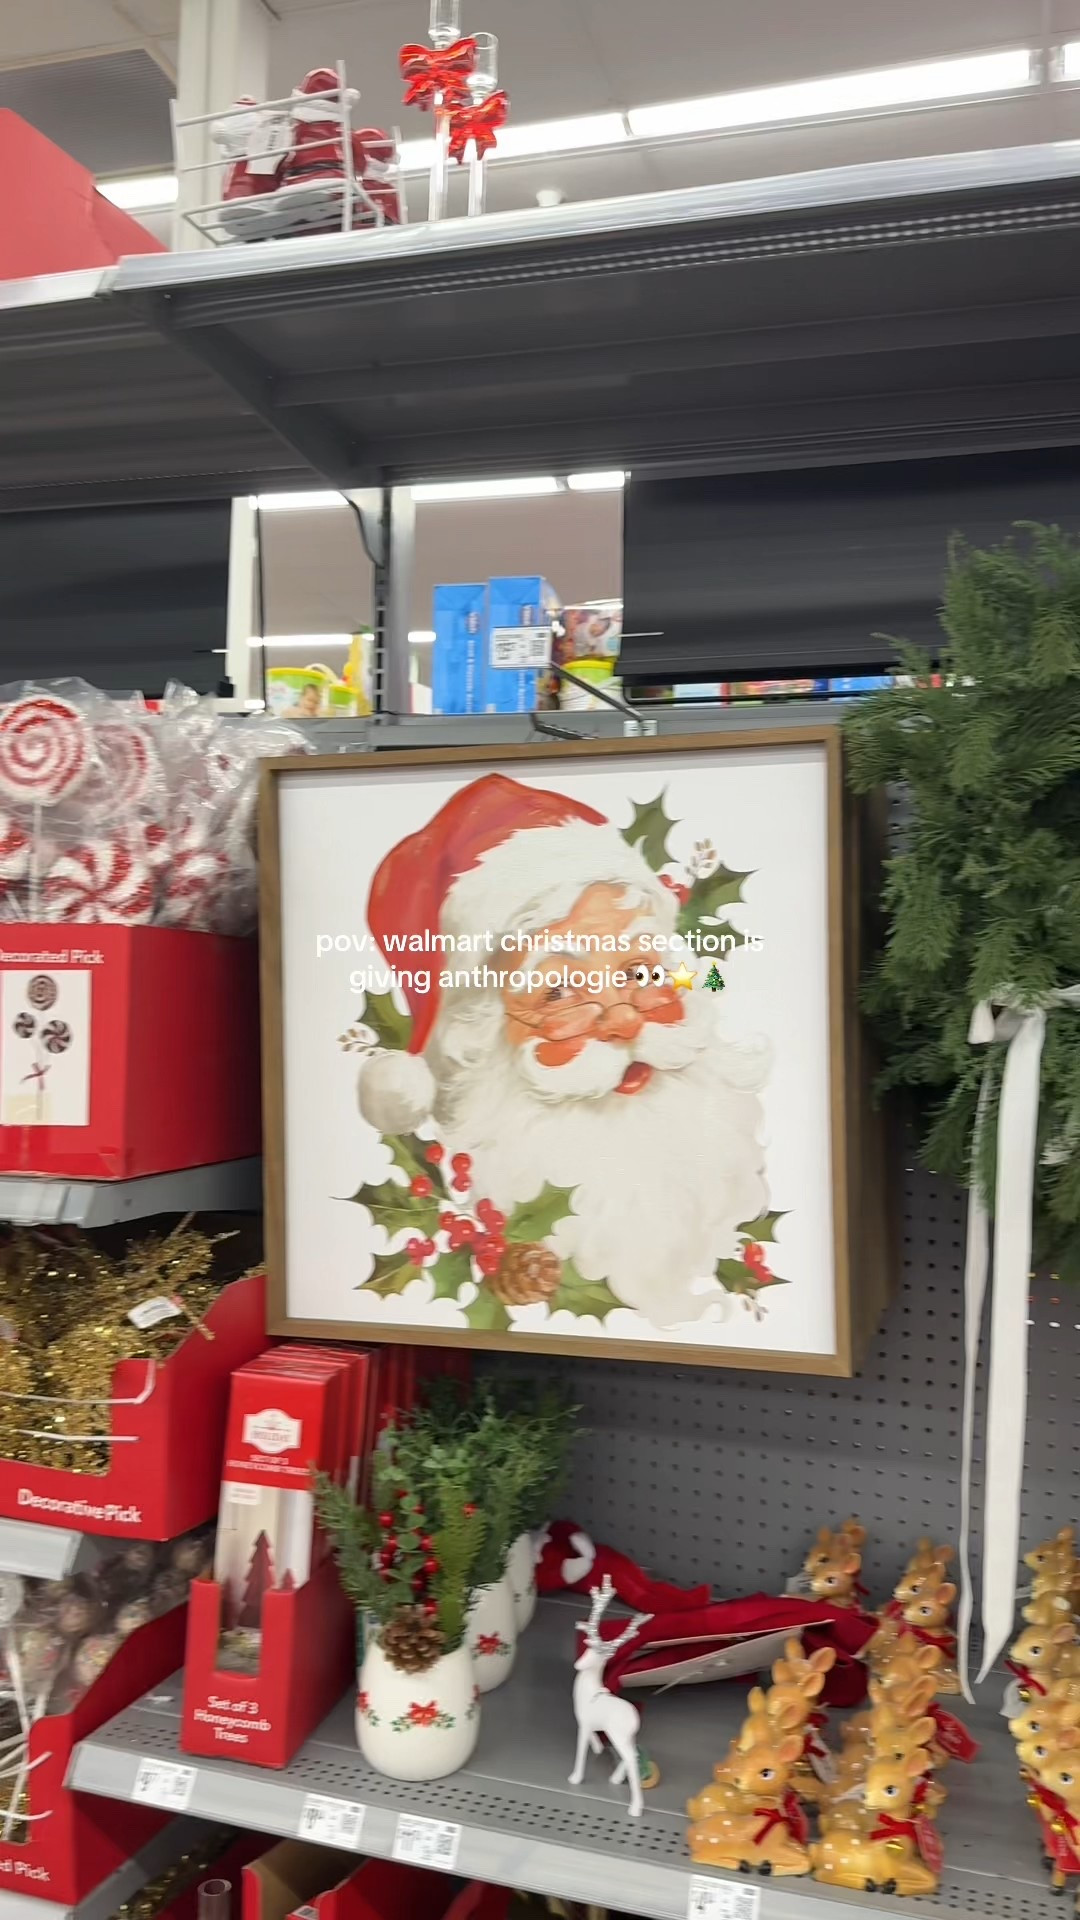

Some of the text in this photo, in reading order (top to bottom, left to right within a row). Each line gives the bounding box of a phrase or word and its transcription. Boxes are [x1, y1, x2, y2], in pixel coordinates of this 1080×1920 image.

[70, 949, 104, 964] Pick
[17, 1488, 142, 1523] Decorative Pick
[207, 1695, 259, 1715] Set of 3
[193, 1708, 272, 1731] Honeycomb
[213, 1726, 249, 1744] Trees
[14, 1861, 51, 1881] Pick
